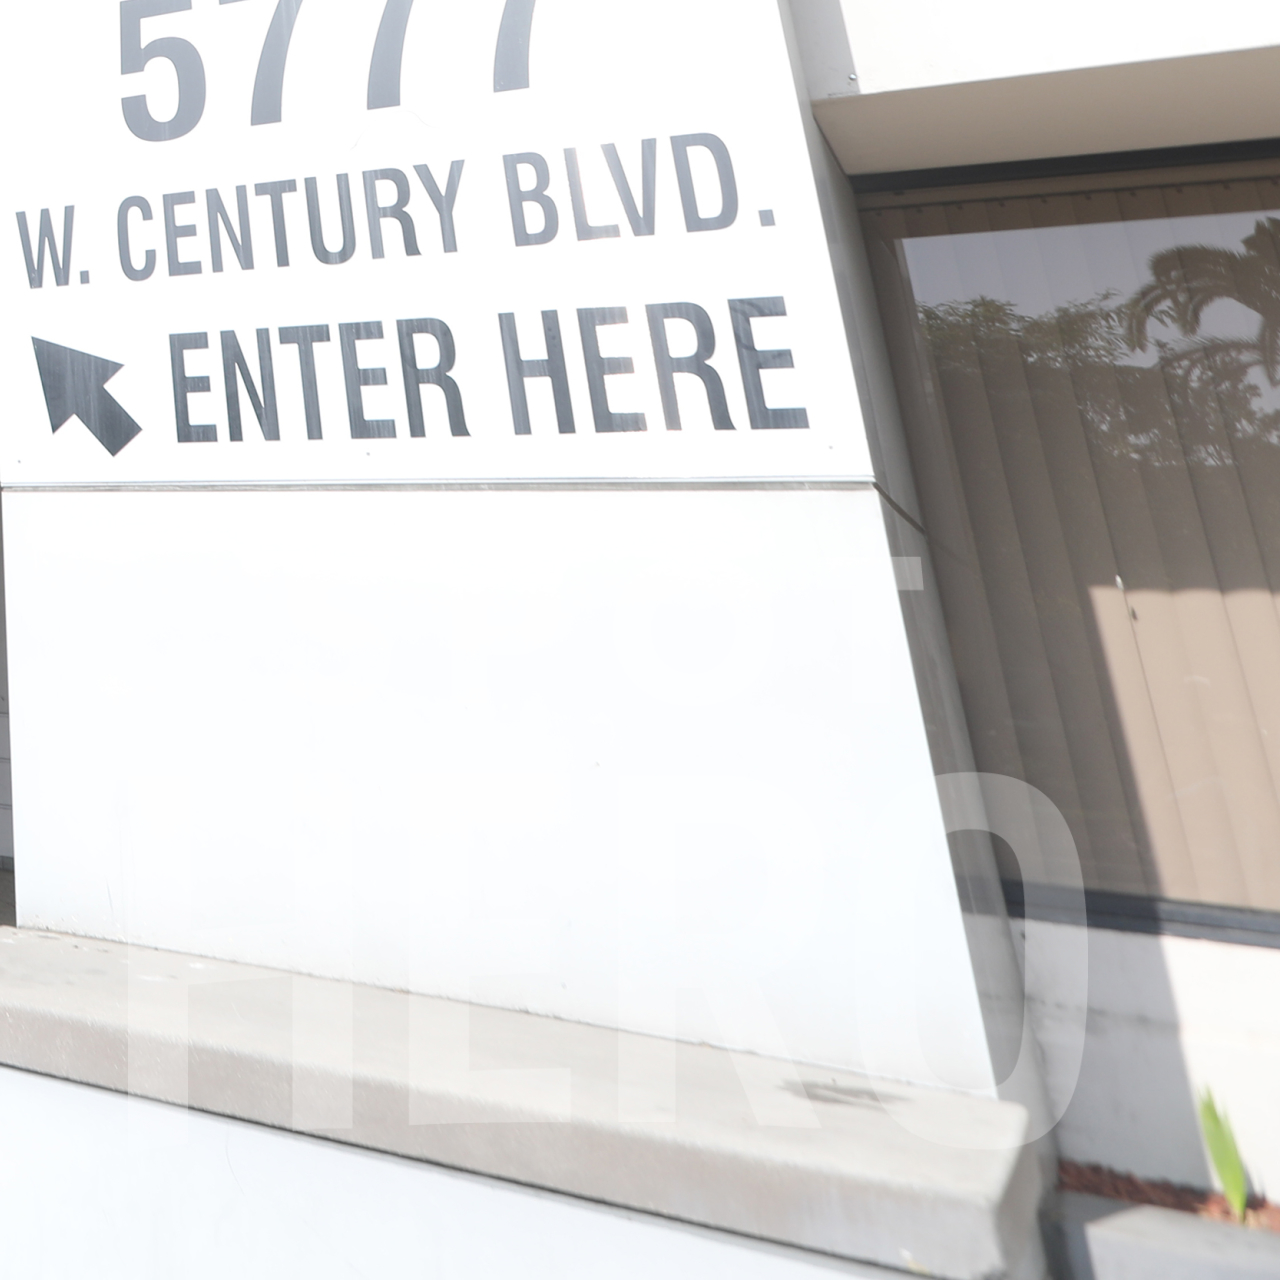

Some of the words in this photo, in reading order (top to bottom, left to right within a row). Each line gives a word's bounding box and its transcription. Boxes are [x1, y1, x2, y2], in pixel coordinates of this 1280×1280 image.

[15, 204, 90, 289] W.
[116, 159, 466, 282] CENTURY
[502, 131, 777, 248] BLVD.
[168, 317, 472, 444] ENTER
[498, 296, 811, 437] HERE
